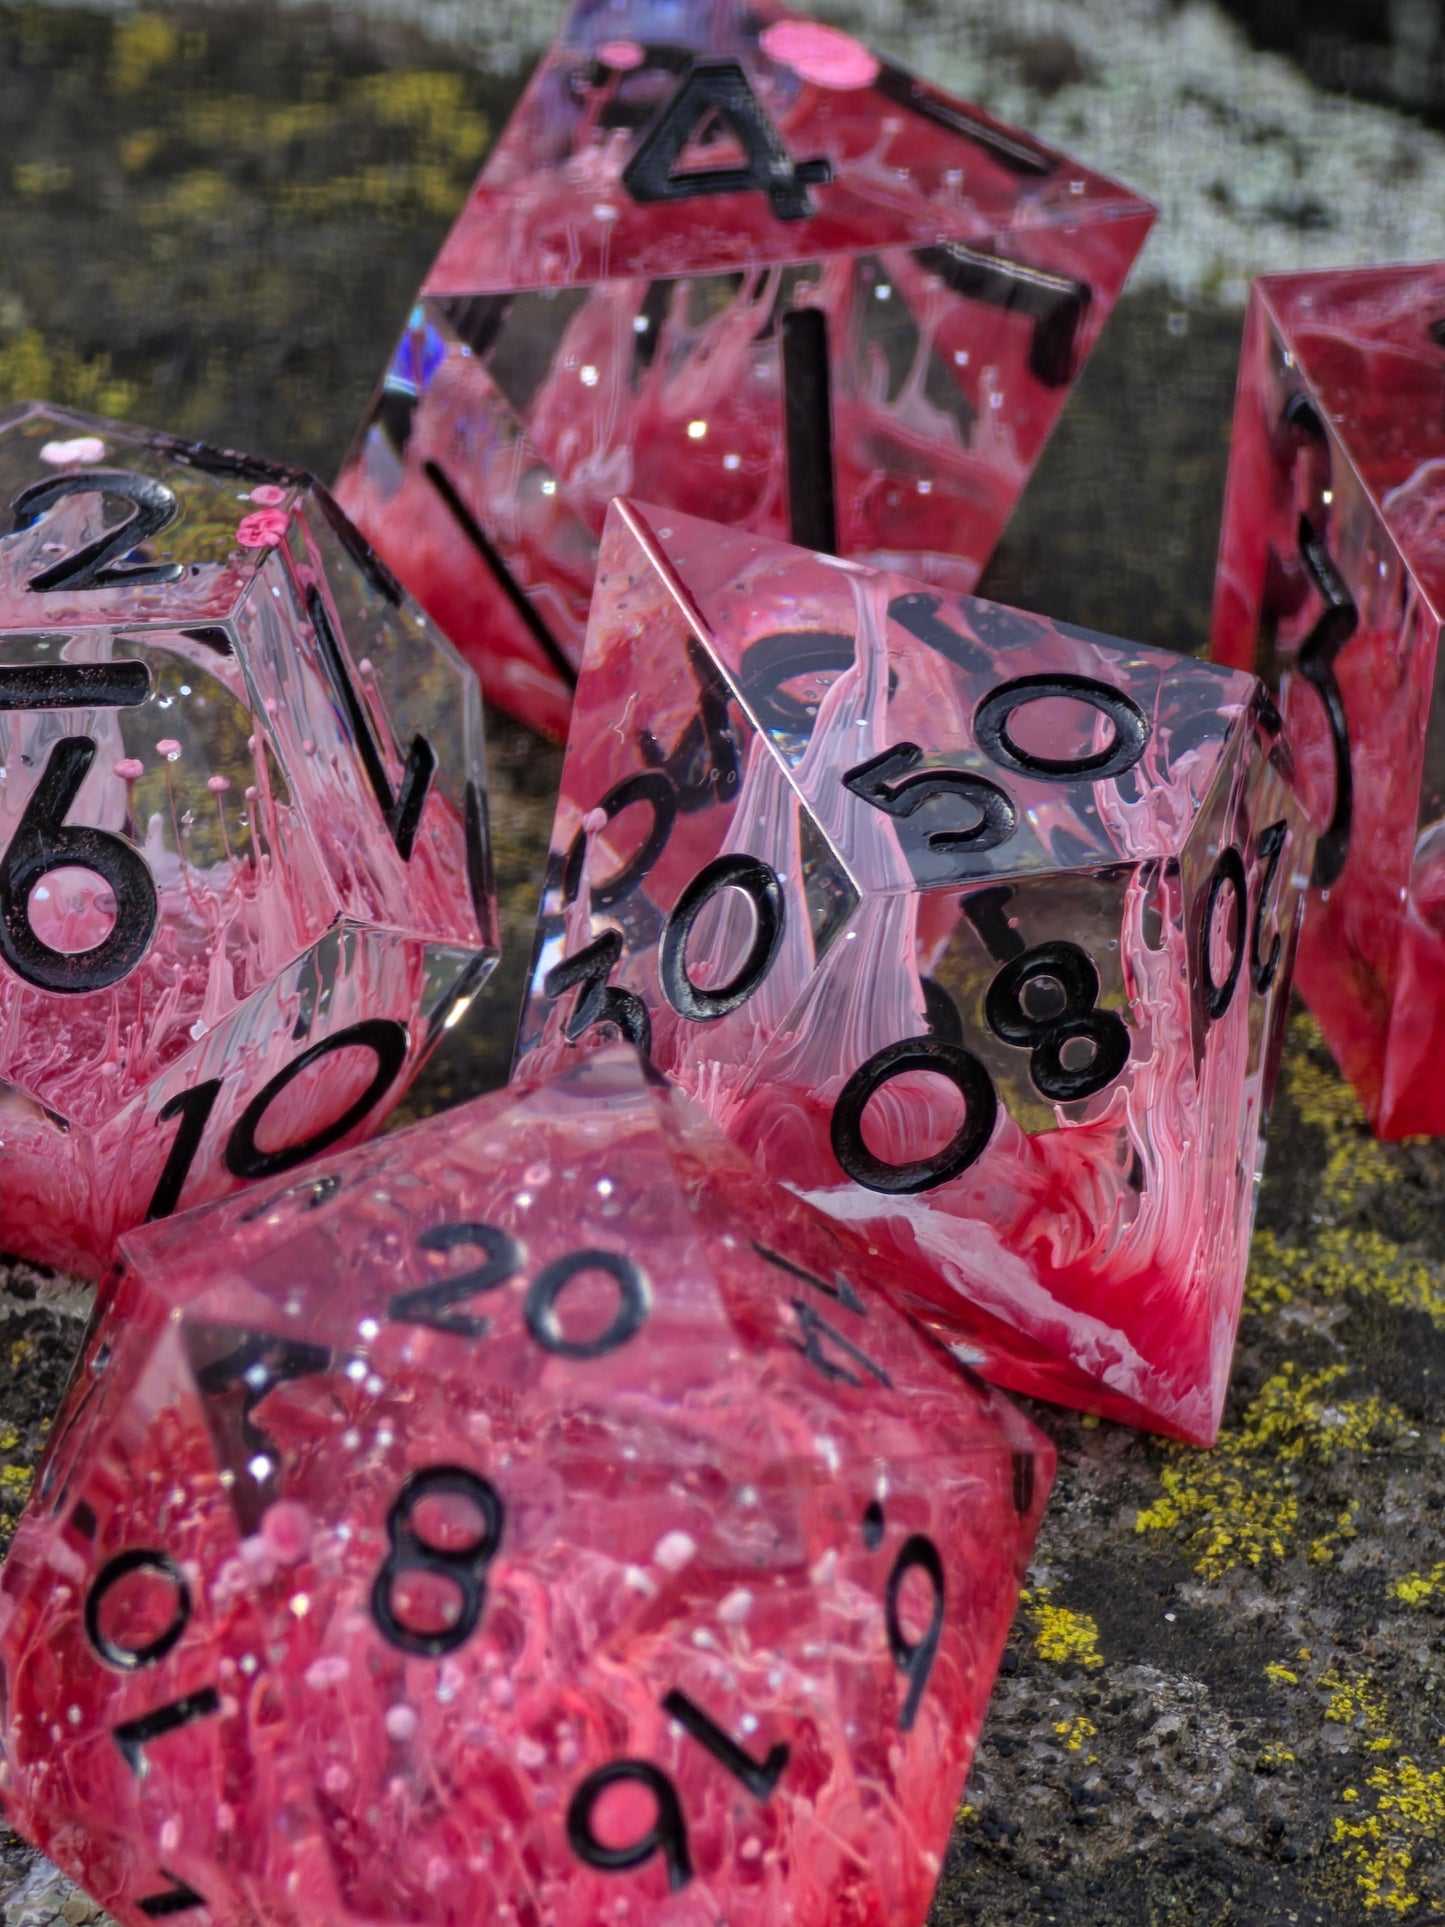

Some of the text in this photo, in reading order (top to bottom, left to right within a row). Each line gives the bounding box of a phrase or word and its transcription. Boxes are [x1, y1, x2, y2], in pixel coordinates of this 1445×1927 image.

[622, 57, 832, 220] 4
[145, 1018, 409, 1222] 10
[388, 1222, 653, 1359] 20
[370, 1465, 506, 1658] 8
